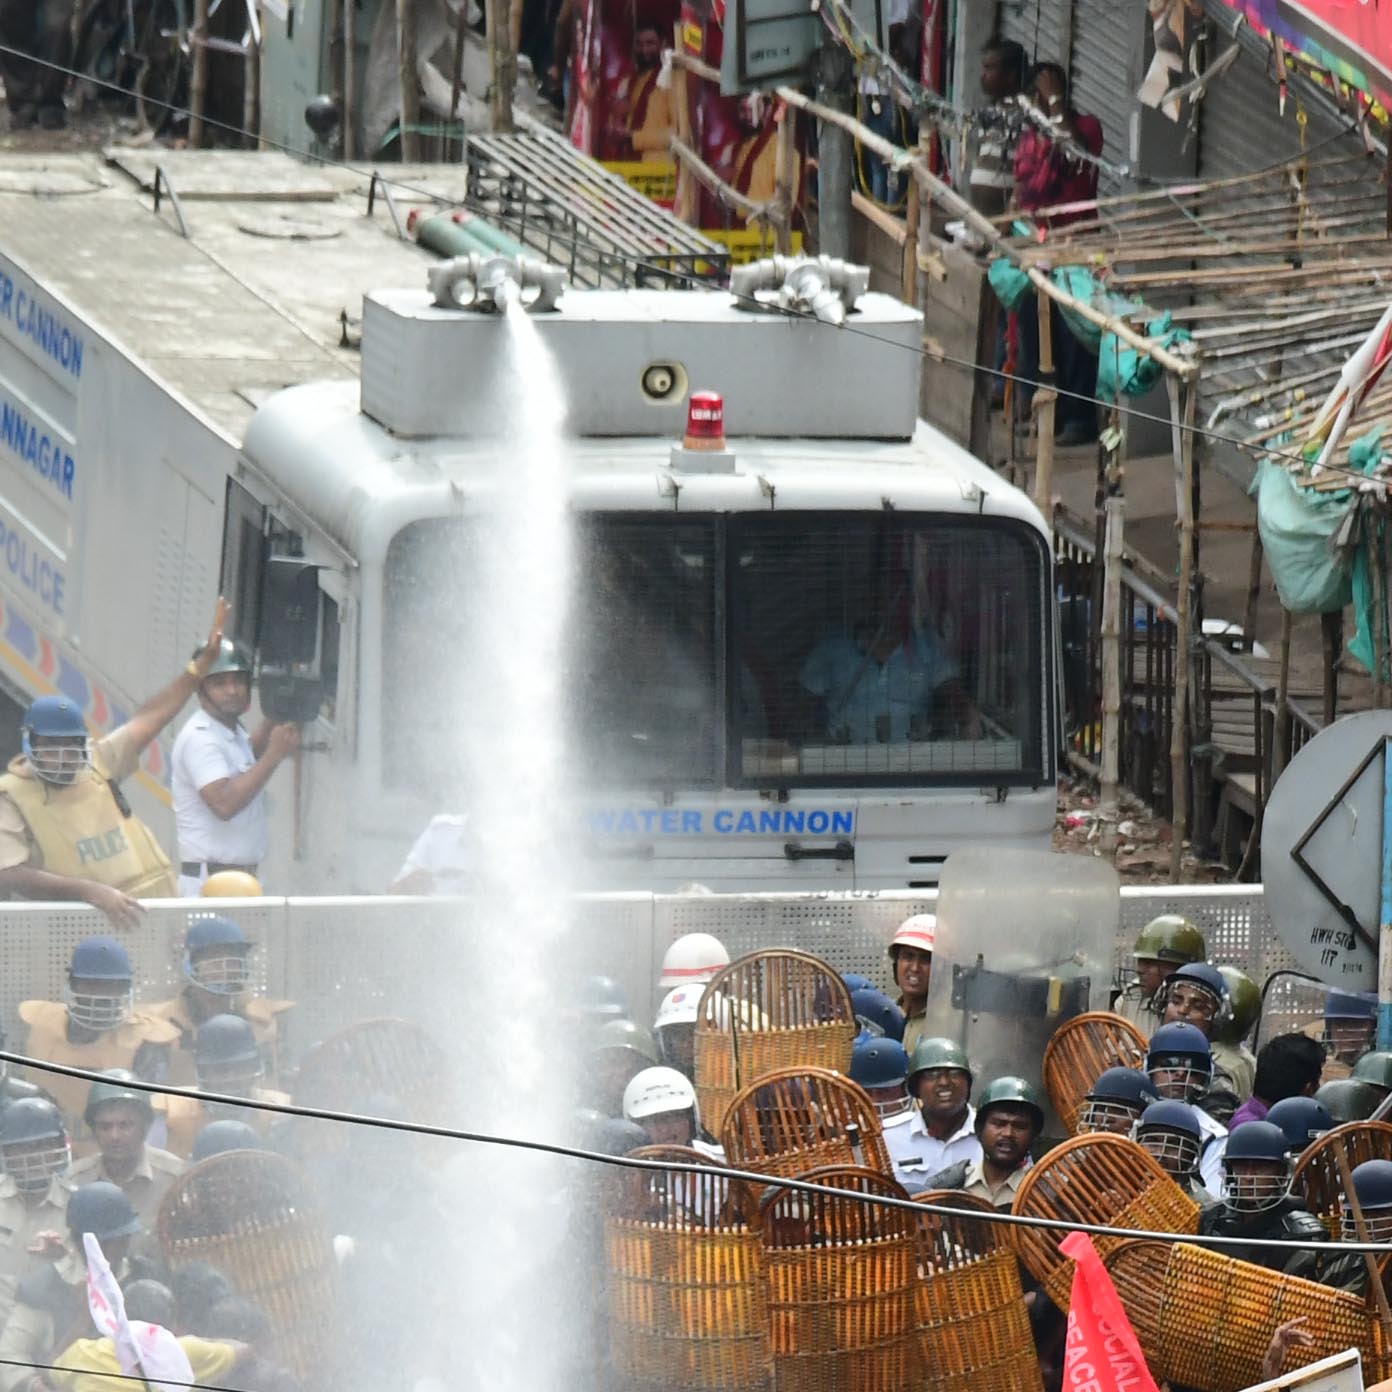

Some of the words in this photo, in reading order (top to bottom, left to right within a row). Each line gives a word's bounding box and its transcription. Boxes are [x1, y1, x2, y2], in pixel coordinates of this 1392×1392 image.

[16, 290, 83, 378] CANNON
[590, 809, 702, 834] WATER
[714, 809, 854, 834] CANNON
